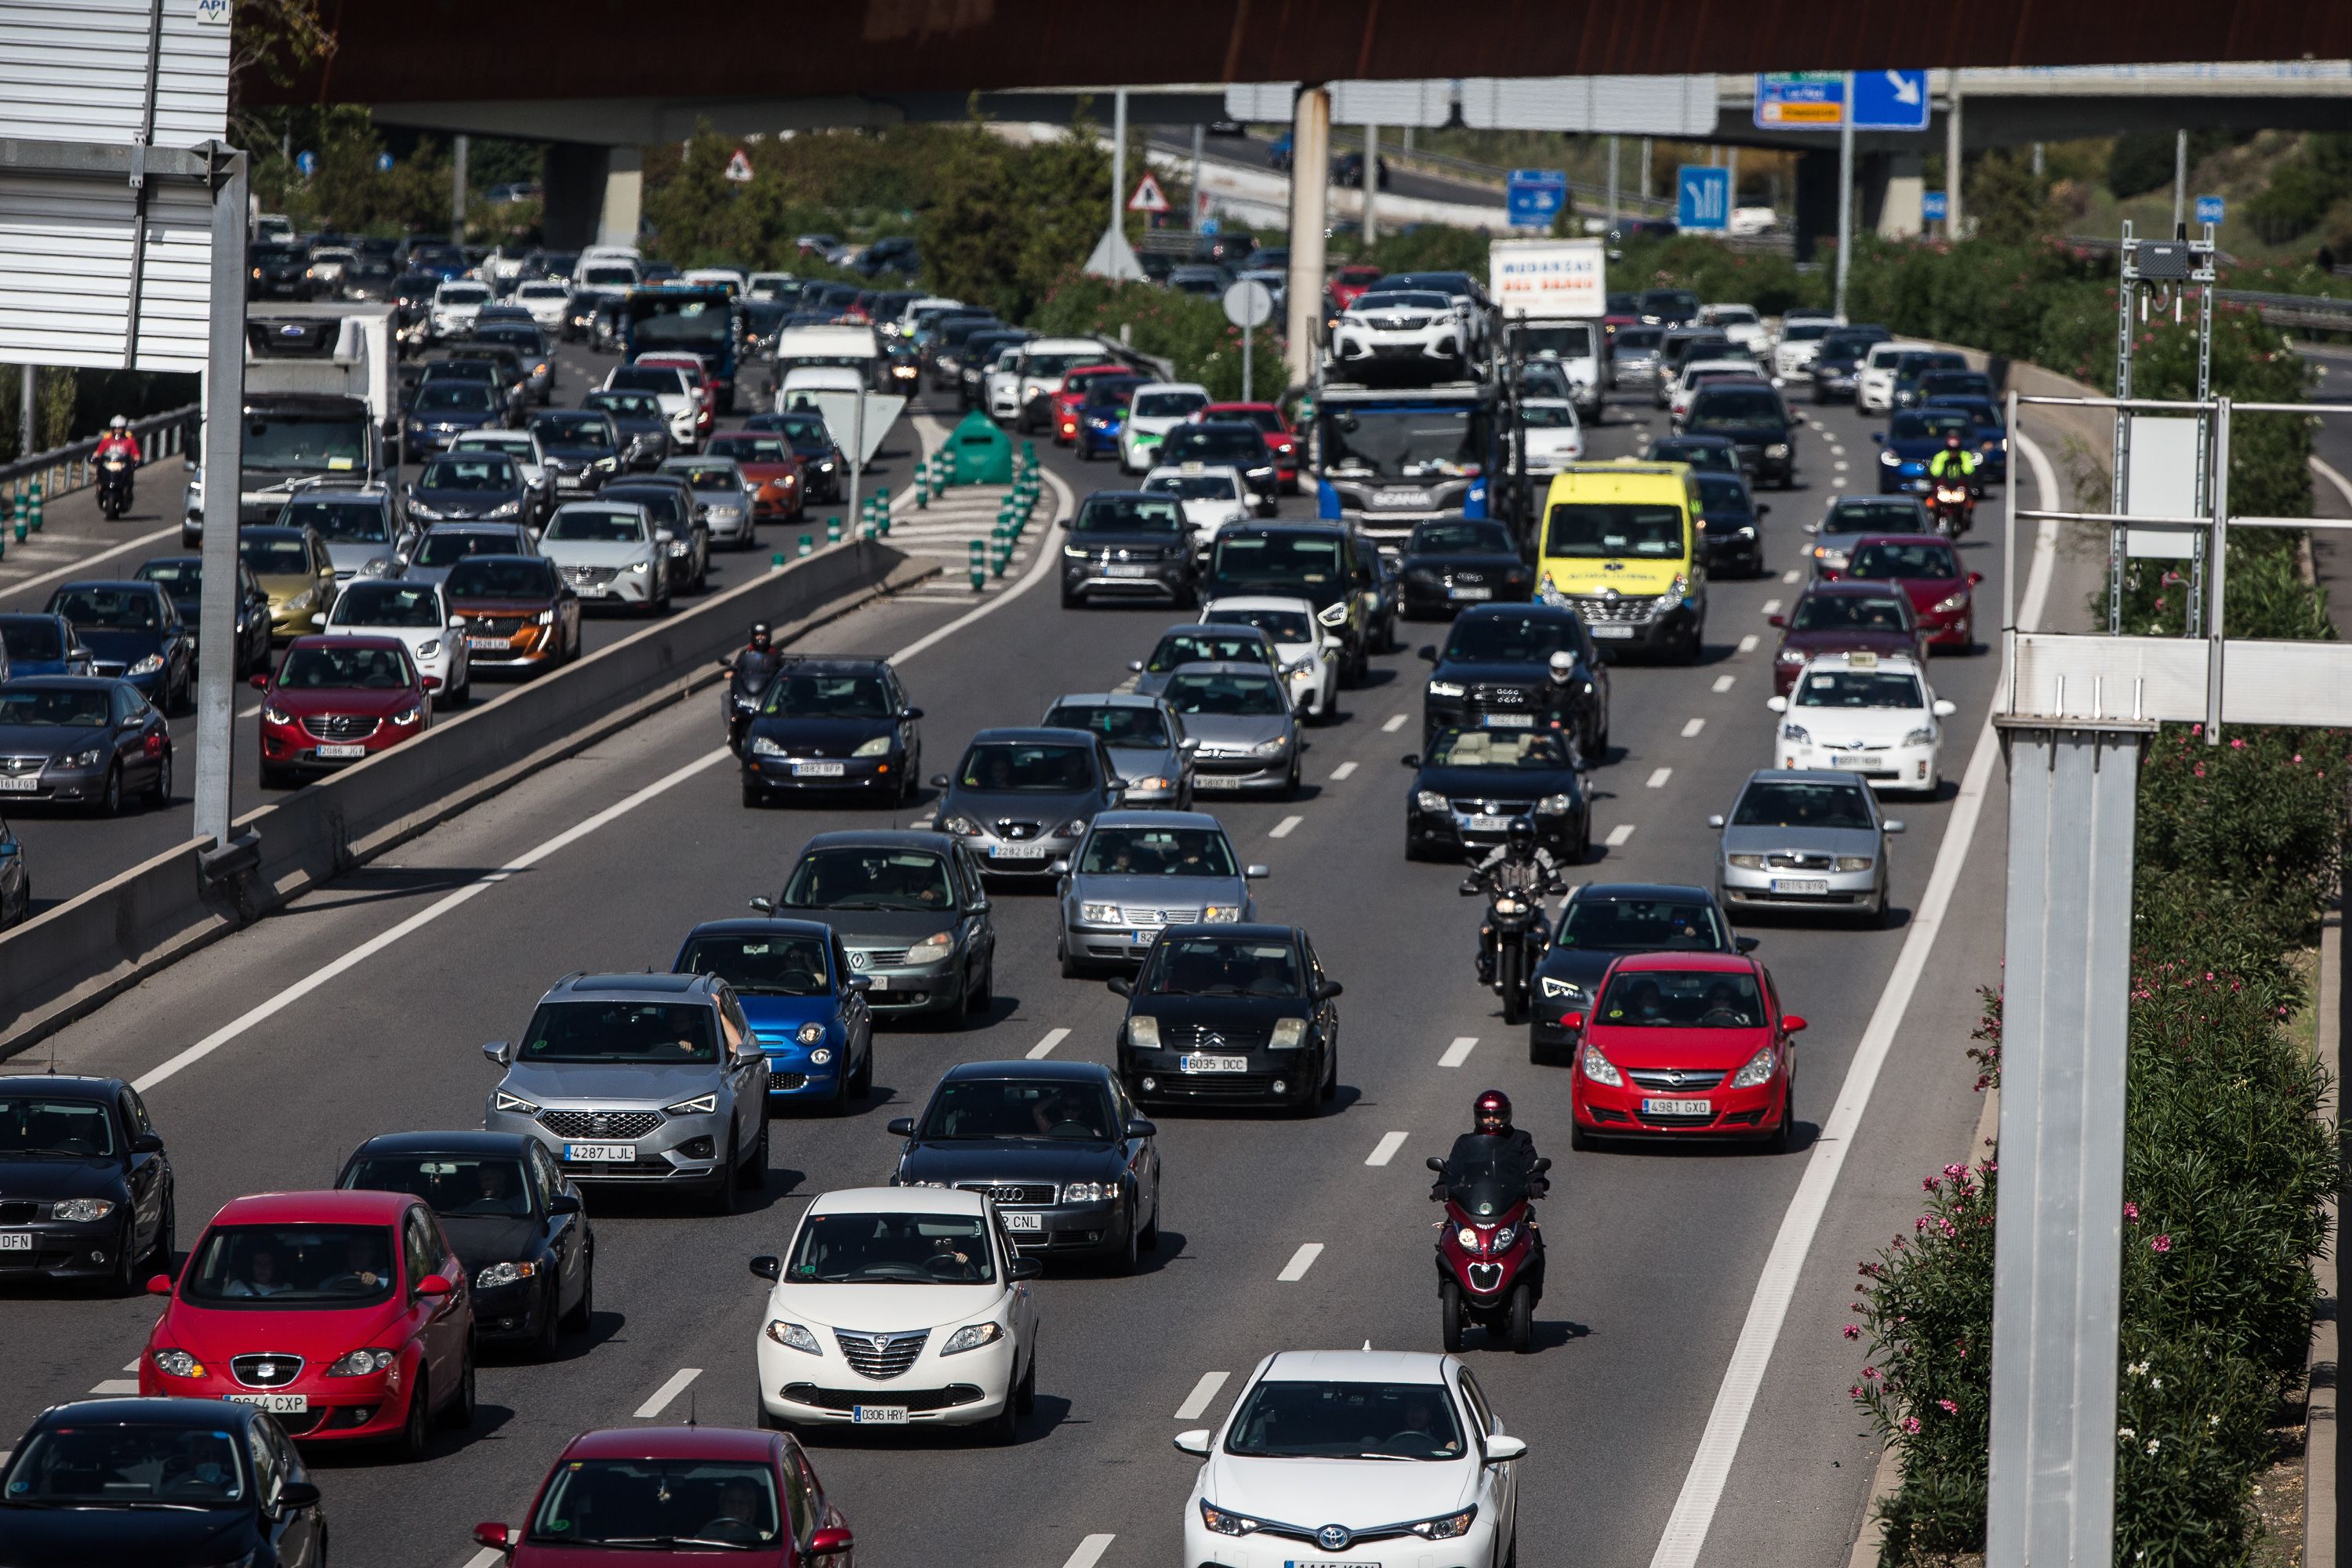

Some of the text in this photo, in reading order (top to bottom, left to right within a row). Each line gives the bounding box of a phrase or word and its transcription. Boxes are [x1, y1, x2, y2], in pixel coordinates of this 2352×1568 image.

[198, 0, 226, 10] API
[1189, 1058, 1243, 1069] 6035 DCC
[1651, 1102, 1707, 1113] 4981 GXD
[573, 1147, 631, 1159] 4287 LJL
[1014, 1216, 1038, 1229] CNL
[275, 1397, 303, 1411] CXP
[862, 1409, 904, 1421] 0306 HRY
